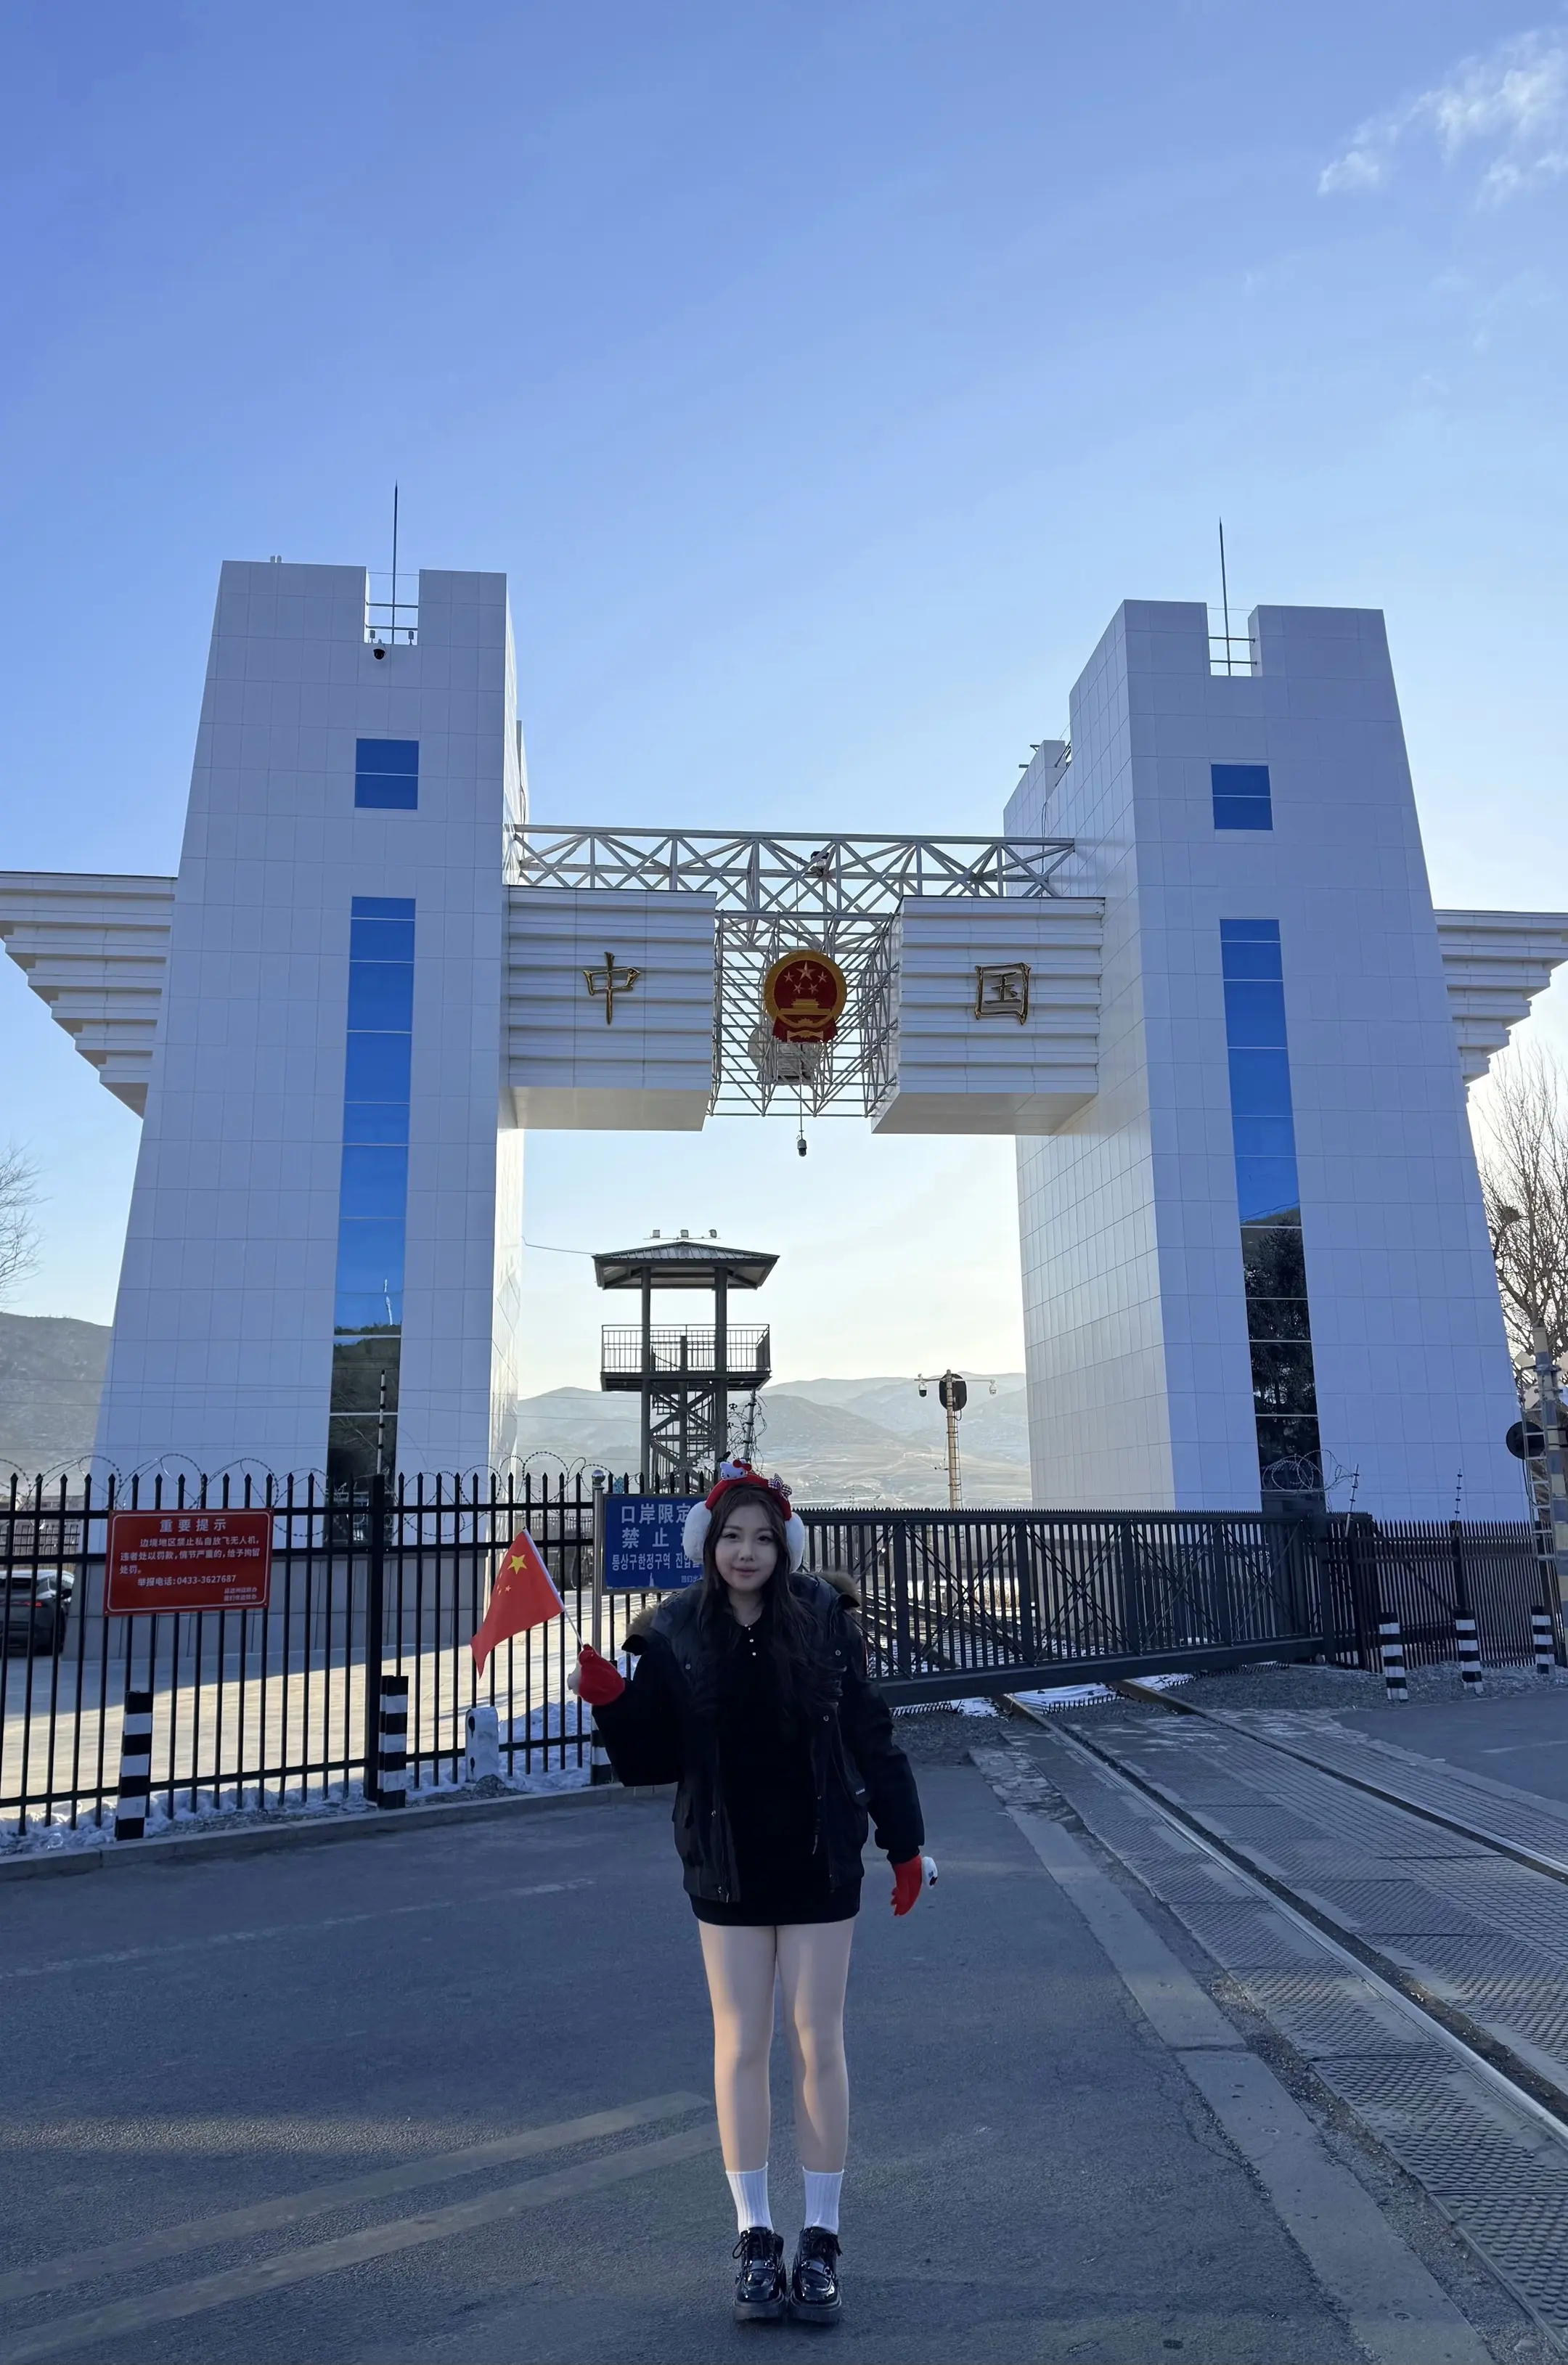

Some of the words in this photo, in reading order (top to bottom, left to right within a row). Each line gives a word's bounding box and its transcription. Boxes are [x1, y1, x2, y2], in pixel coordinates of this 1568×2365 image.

[583, 951, 641, 1026] 中
[975, 962, 1032, 1026] 国
[621, 1503, 690, 1524] 口岸限定
[159, 1519, 226, 1533] 重要提示
[621, 1527, 685, 1549] 禁止
[611, 1552, 671, 1571] 통상구한정구역
